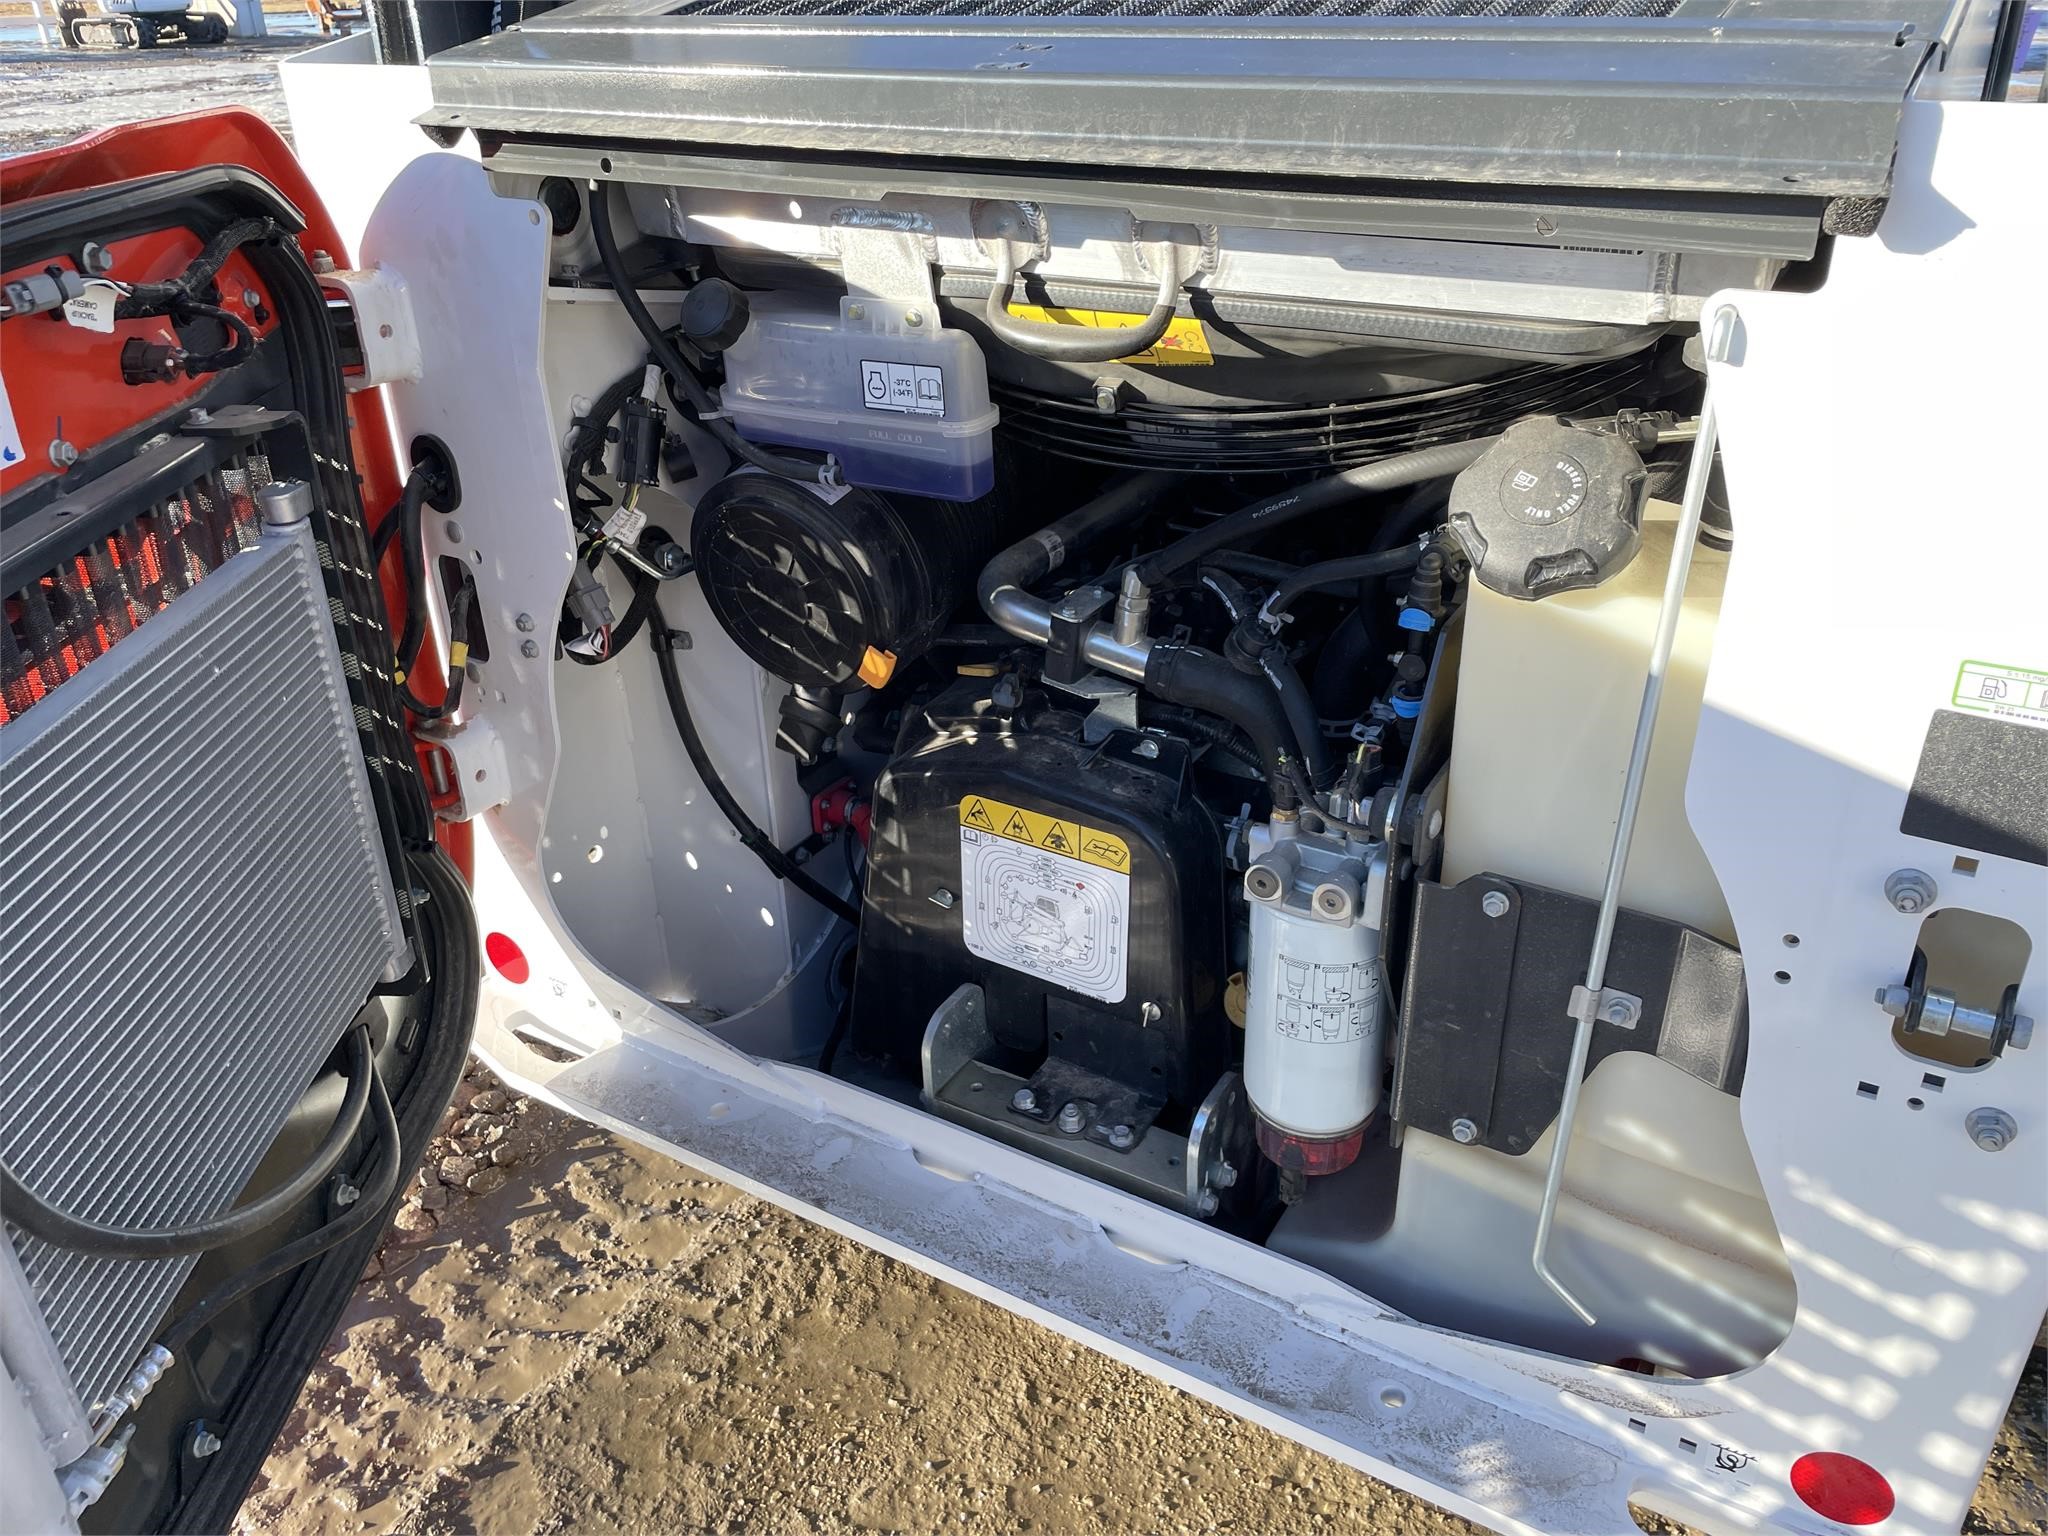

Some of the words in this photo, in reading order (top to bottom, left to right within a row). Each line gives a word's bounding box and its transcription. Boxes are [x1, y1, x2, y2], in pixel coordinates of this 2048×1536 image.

[1556, 461, 1583, 489] DIESEL
[1524, 506, 1551, 519] ONLY
[1556, 494, 1580, 514] FUEL
